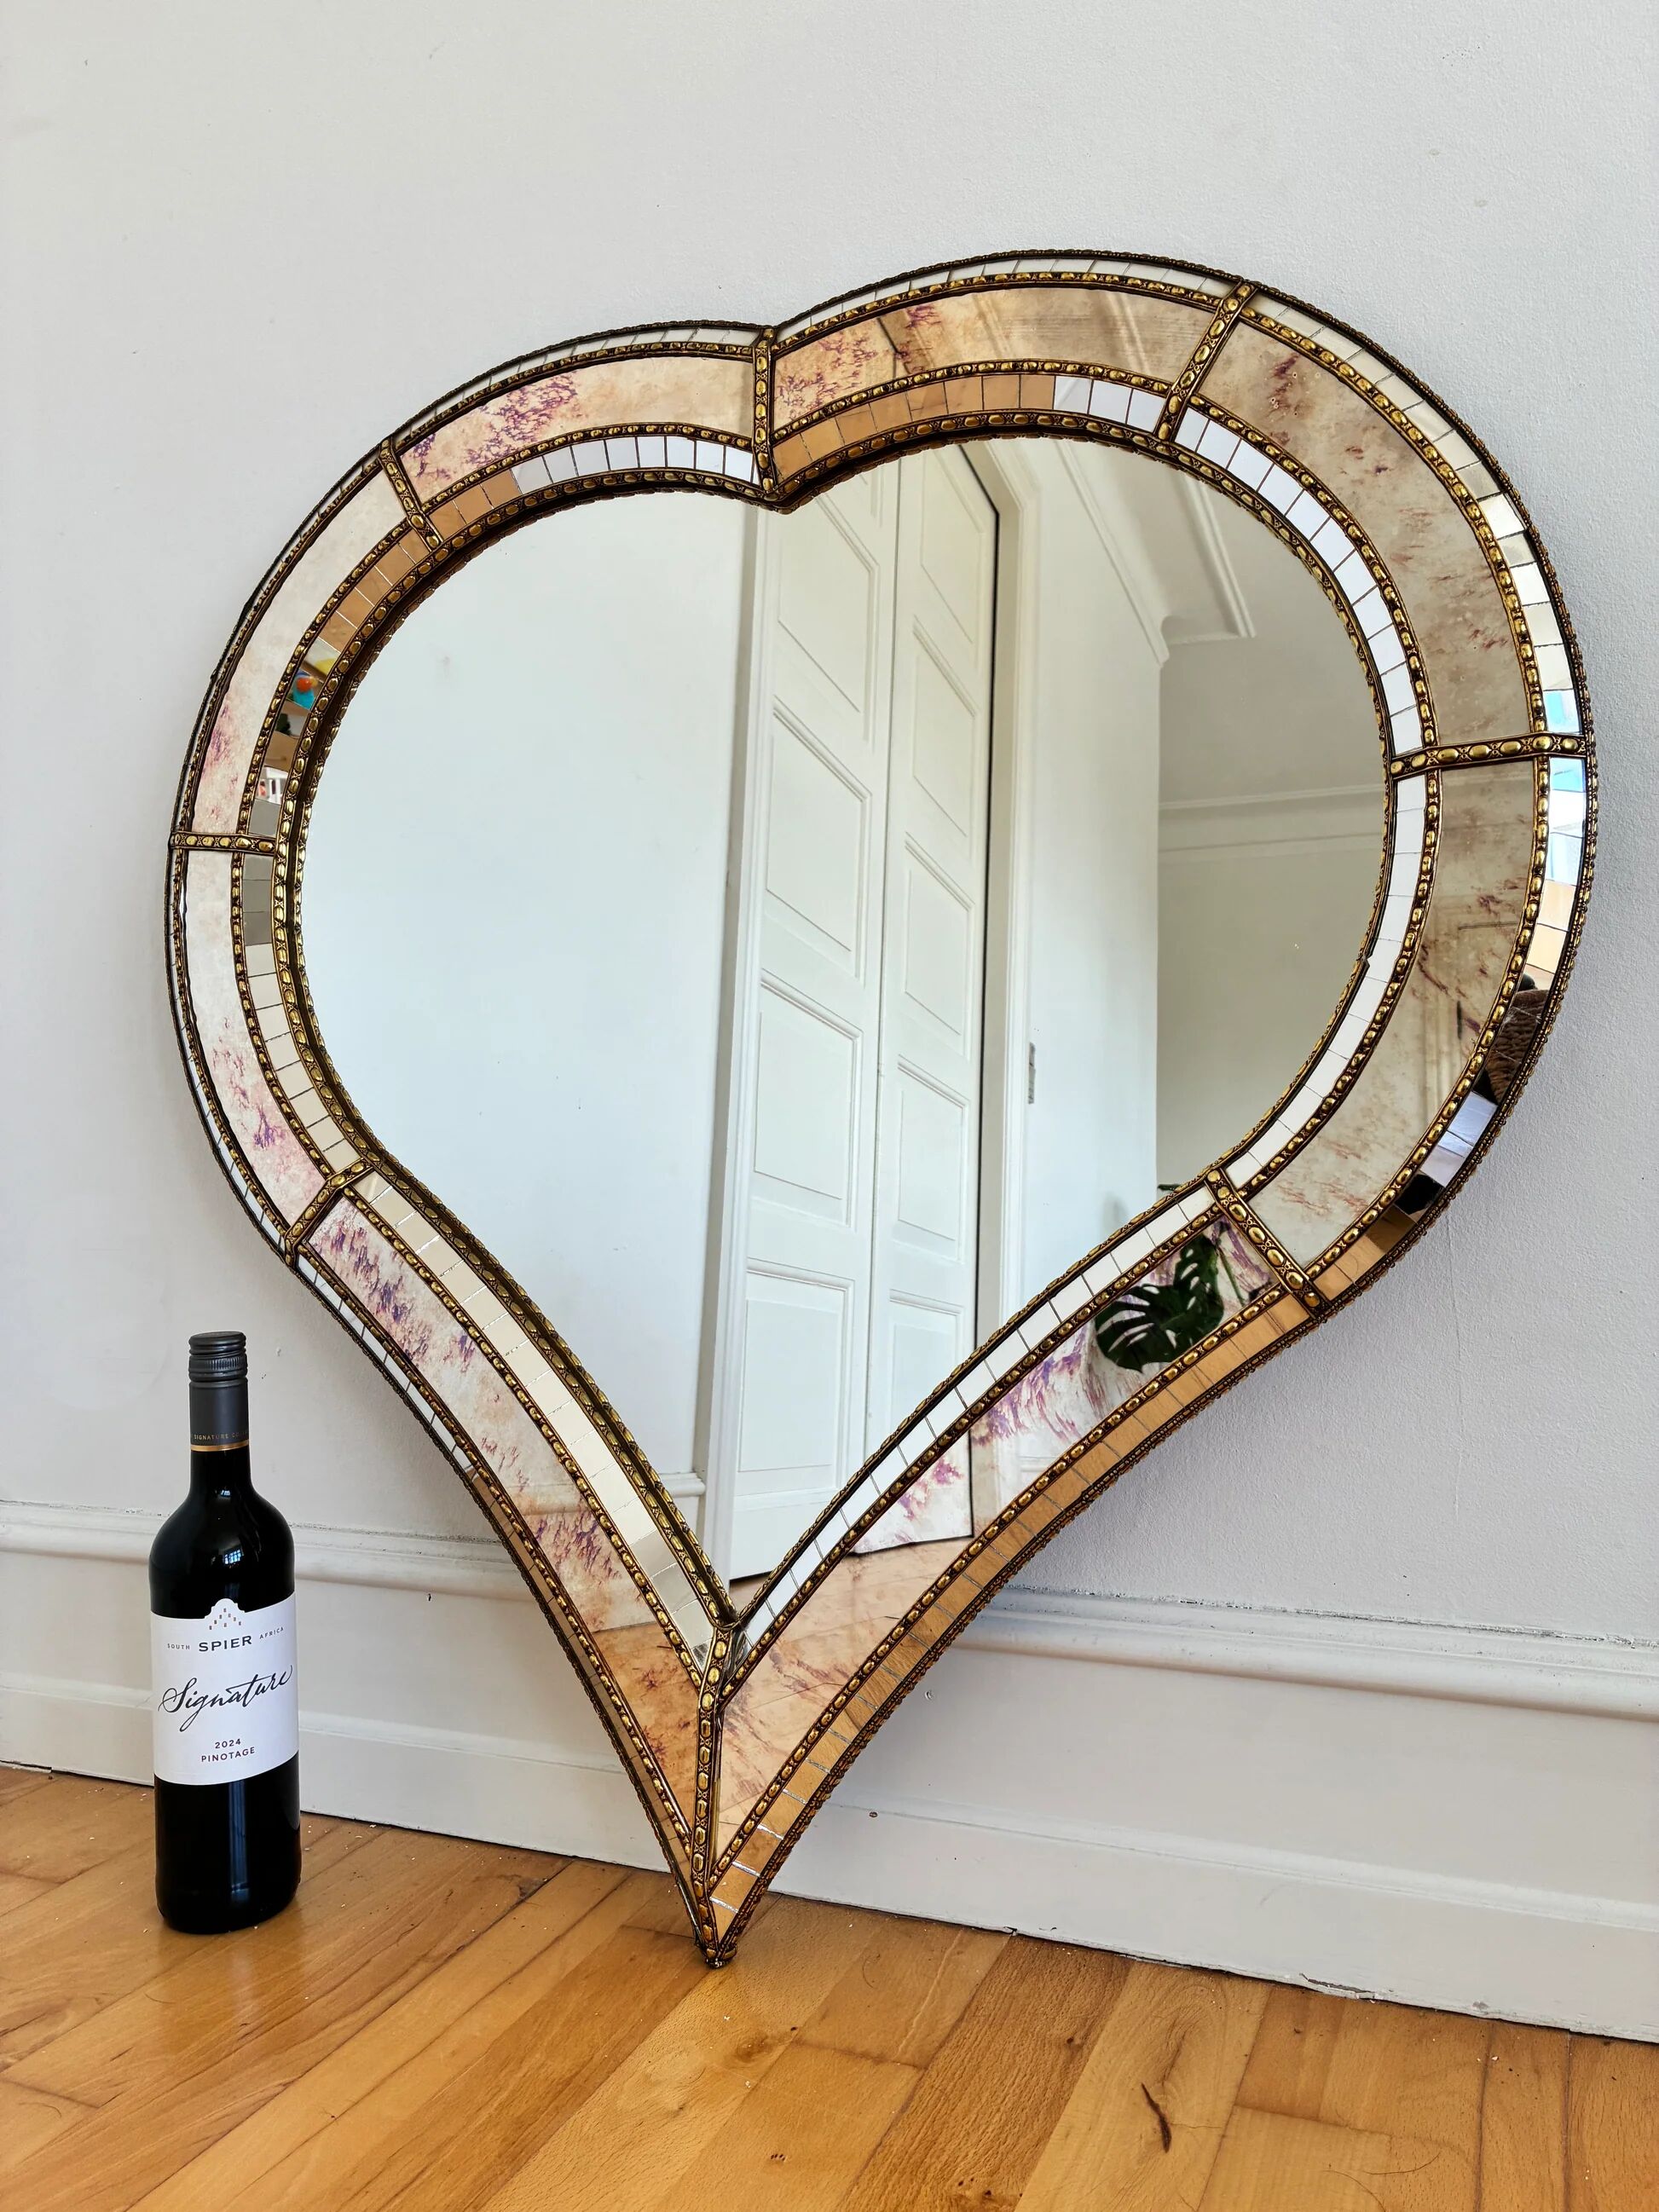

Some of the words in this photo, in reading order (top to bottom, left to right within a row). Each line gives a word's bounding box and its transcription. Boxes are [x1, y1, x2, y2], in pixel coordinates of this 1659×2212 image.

[198, 1635, 252, 1652] SPIER
[259, 1626, 285, 1639] AFRICA
[158, 1665, 293, 1732] Signature
[215, 1738, 242, 1749] 2024
[201, 1747, 256, 1762] PINOTAGE
